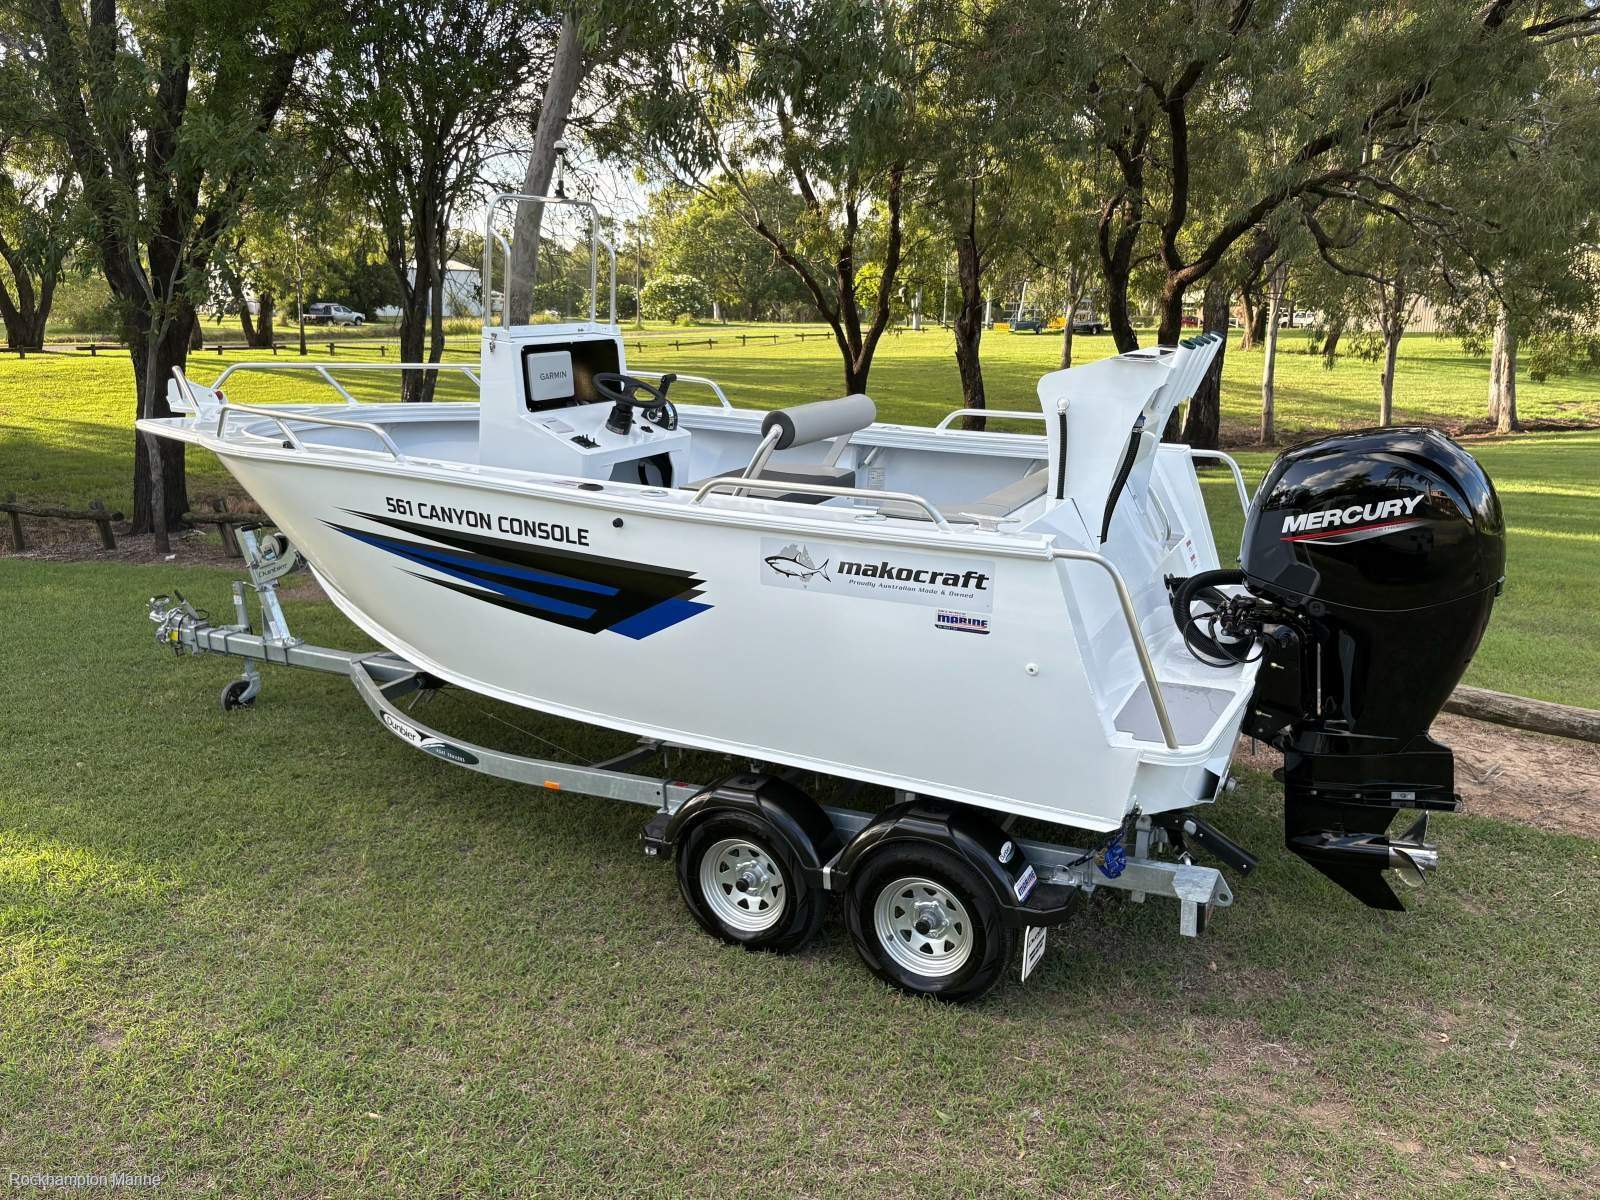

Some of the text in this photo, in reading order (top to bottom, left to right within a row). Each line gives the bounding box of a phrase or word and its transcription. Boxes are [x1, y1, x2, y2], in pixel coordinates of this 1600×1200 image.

[540, 371, 567, 381] GARMIN
[386, 497, 590, 546] 561 CANYON CONSOLE
[1281, 494, 1425, 534] MERCURY
[837, 561, 990, 590] makocraft
[848, 579, 876, 588] Proudly
[878, 582, 916, 592] Australian
[918, 587, 938, 595] Made
[949, 591, 974, 599] Owned
[937, 614, 989, 628] MARINE
[385, 716, 417, 741] Dunbier
